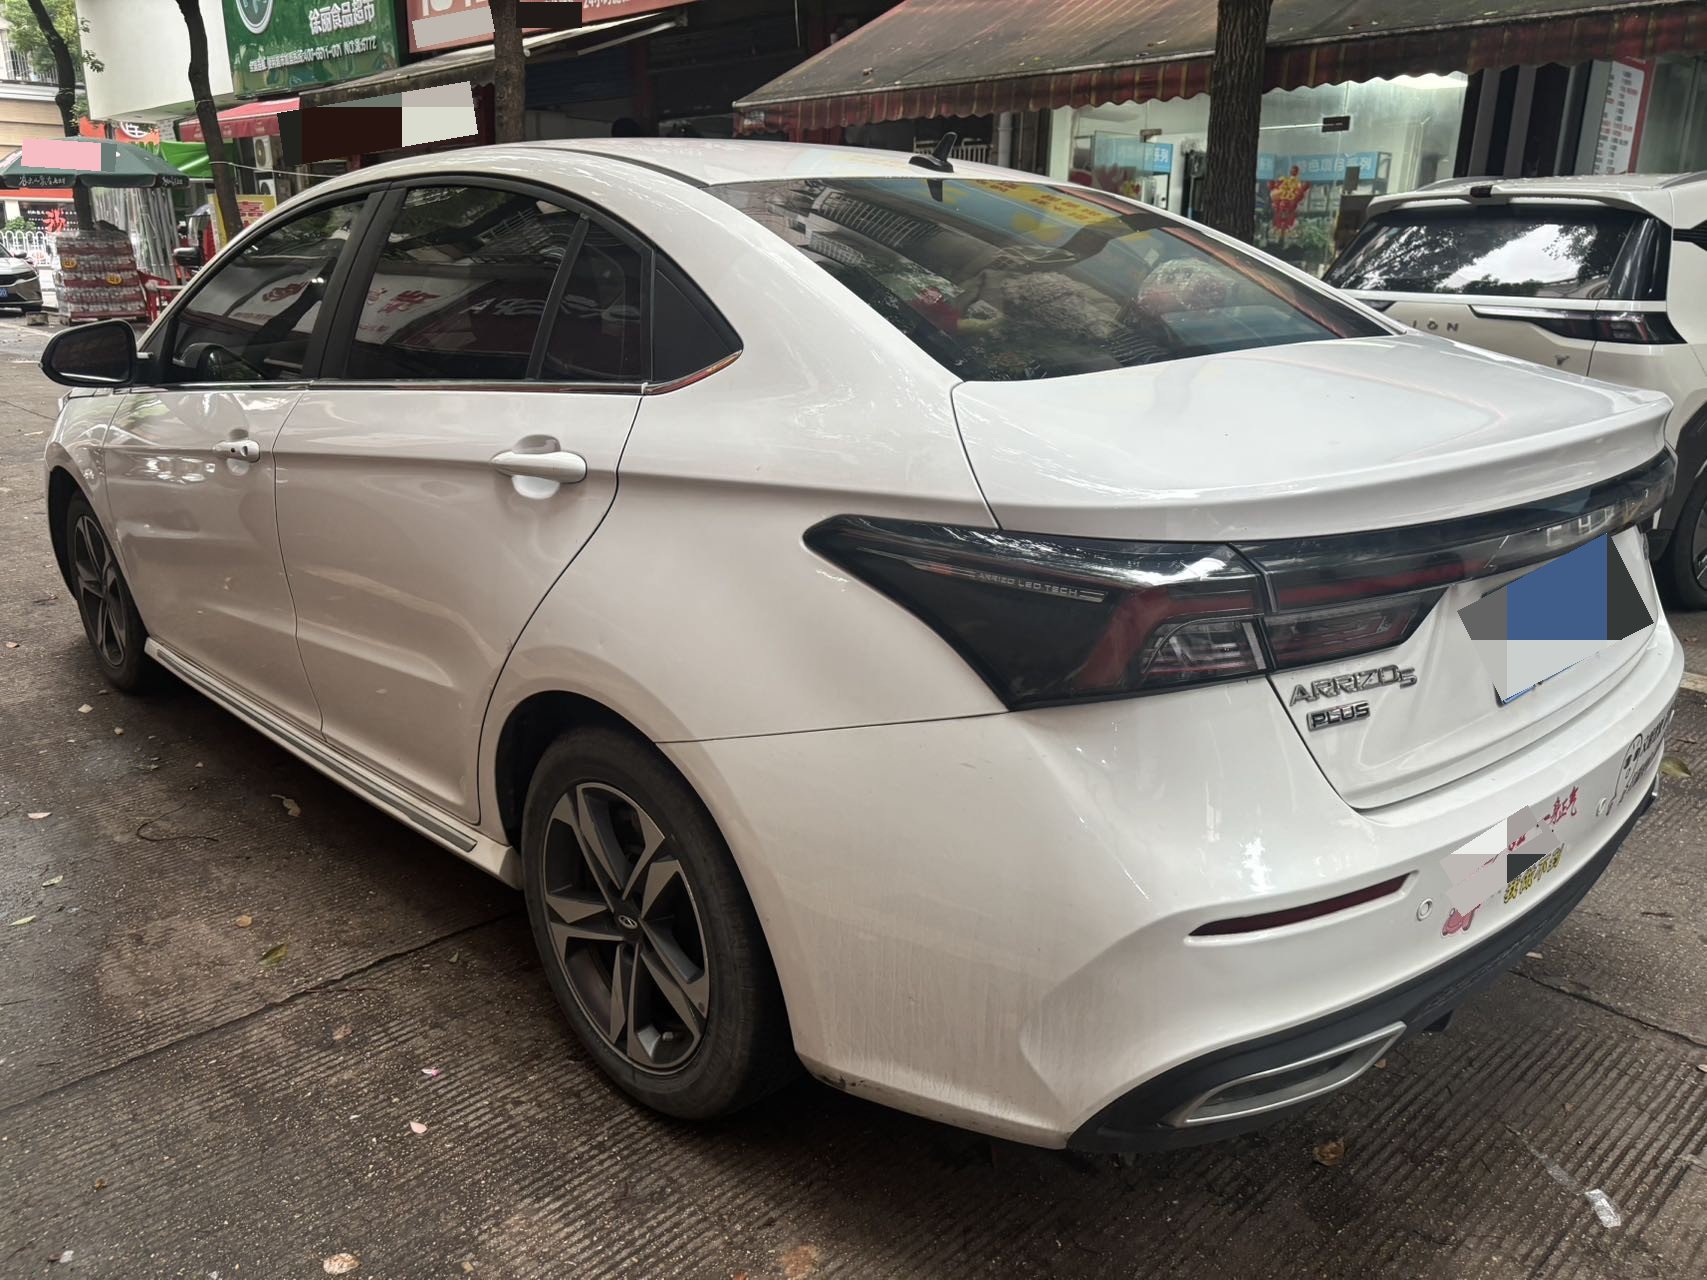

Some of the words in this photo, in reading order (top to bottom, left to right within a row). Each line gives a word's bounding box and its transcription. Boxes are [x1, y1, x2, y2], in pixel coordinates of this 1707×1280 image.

[1399, 319, 1459, 332] ION
[1017, 579, 1042, 590] LED
[1044, 584, 1079, 597] TECH
[1310, 701, 1370, 728] PLUS
